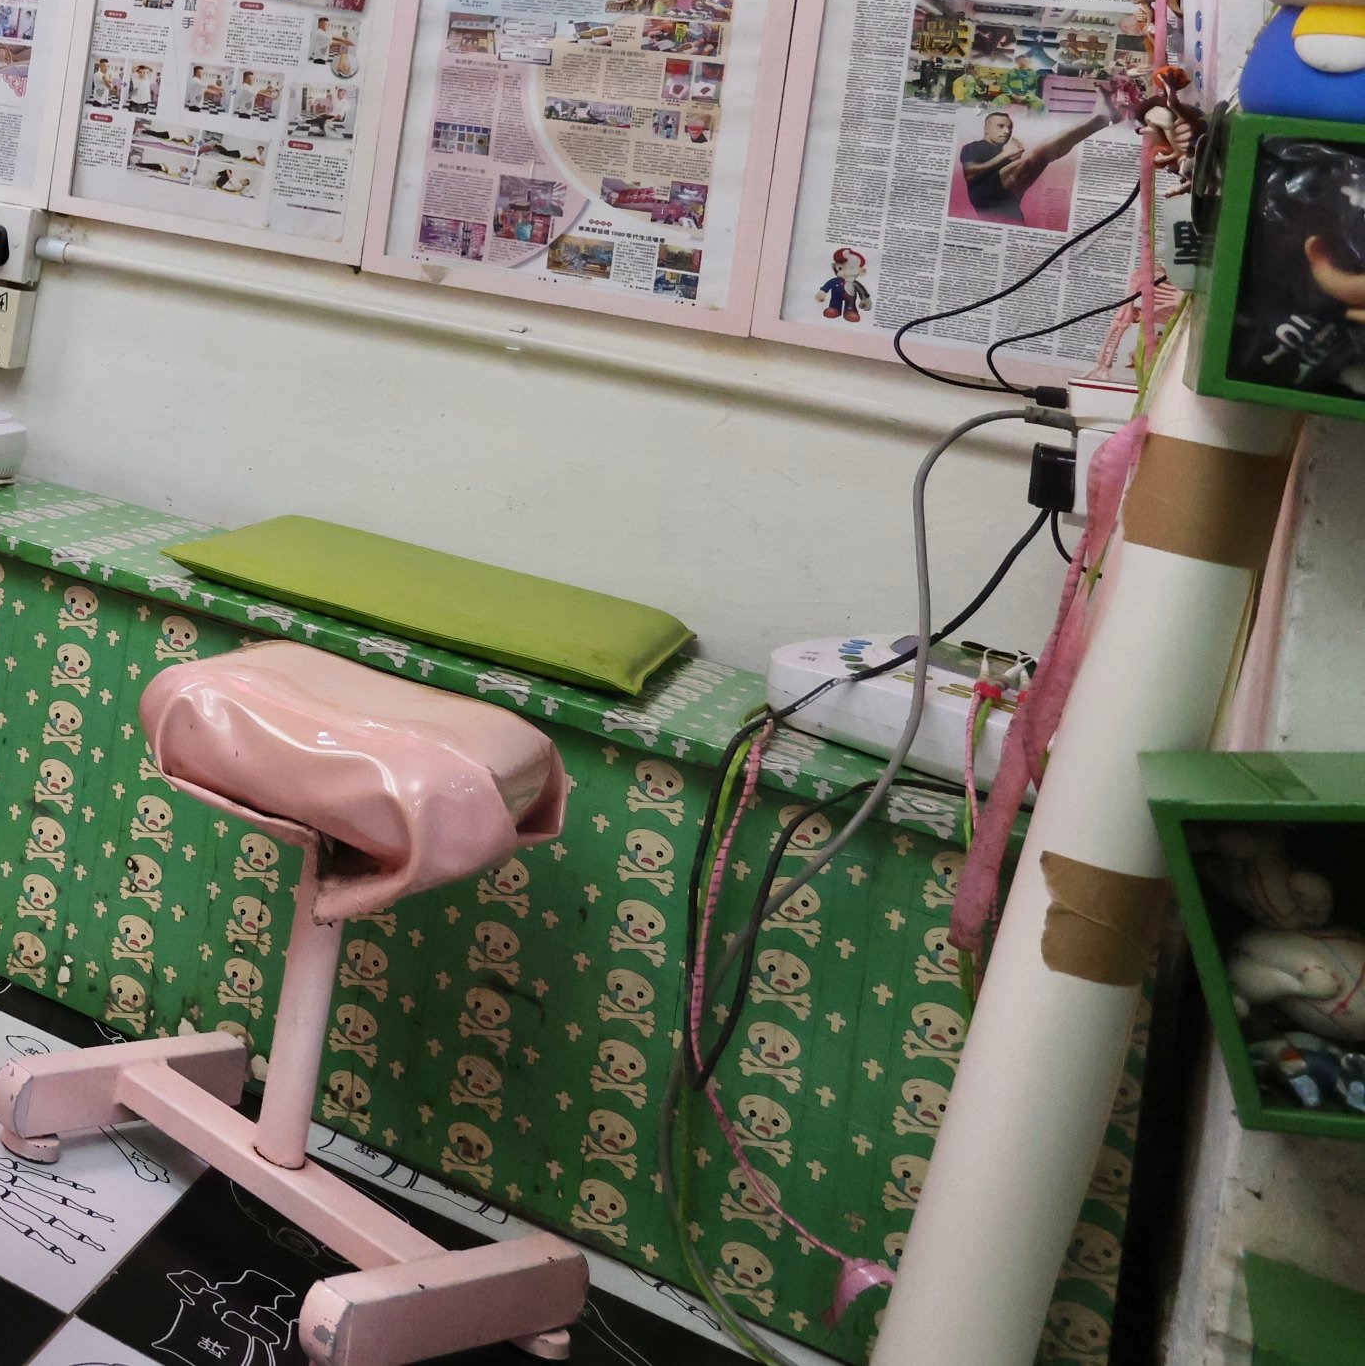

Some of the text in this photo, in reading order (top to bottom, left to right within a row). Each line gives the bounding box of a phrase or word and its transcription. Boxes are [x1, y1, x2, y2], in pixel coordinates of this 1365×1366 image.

[127, 1151, 151, 1165] 打
[353, 1143, 379, 1160] 跌
[197, 1337, 230, 1359] 跌
